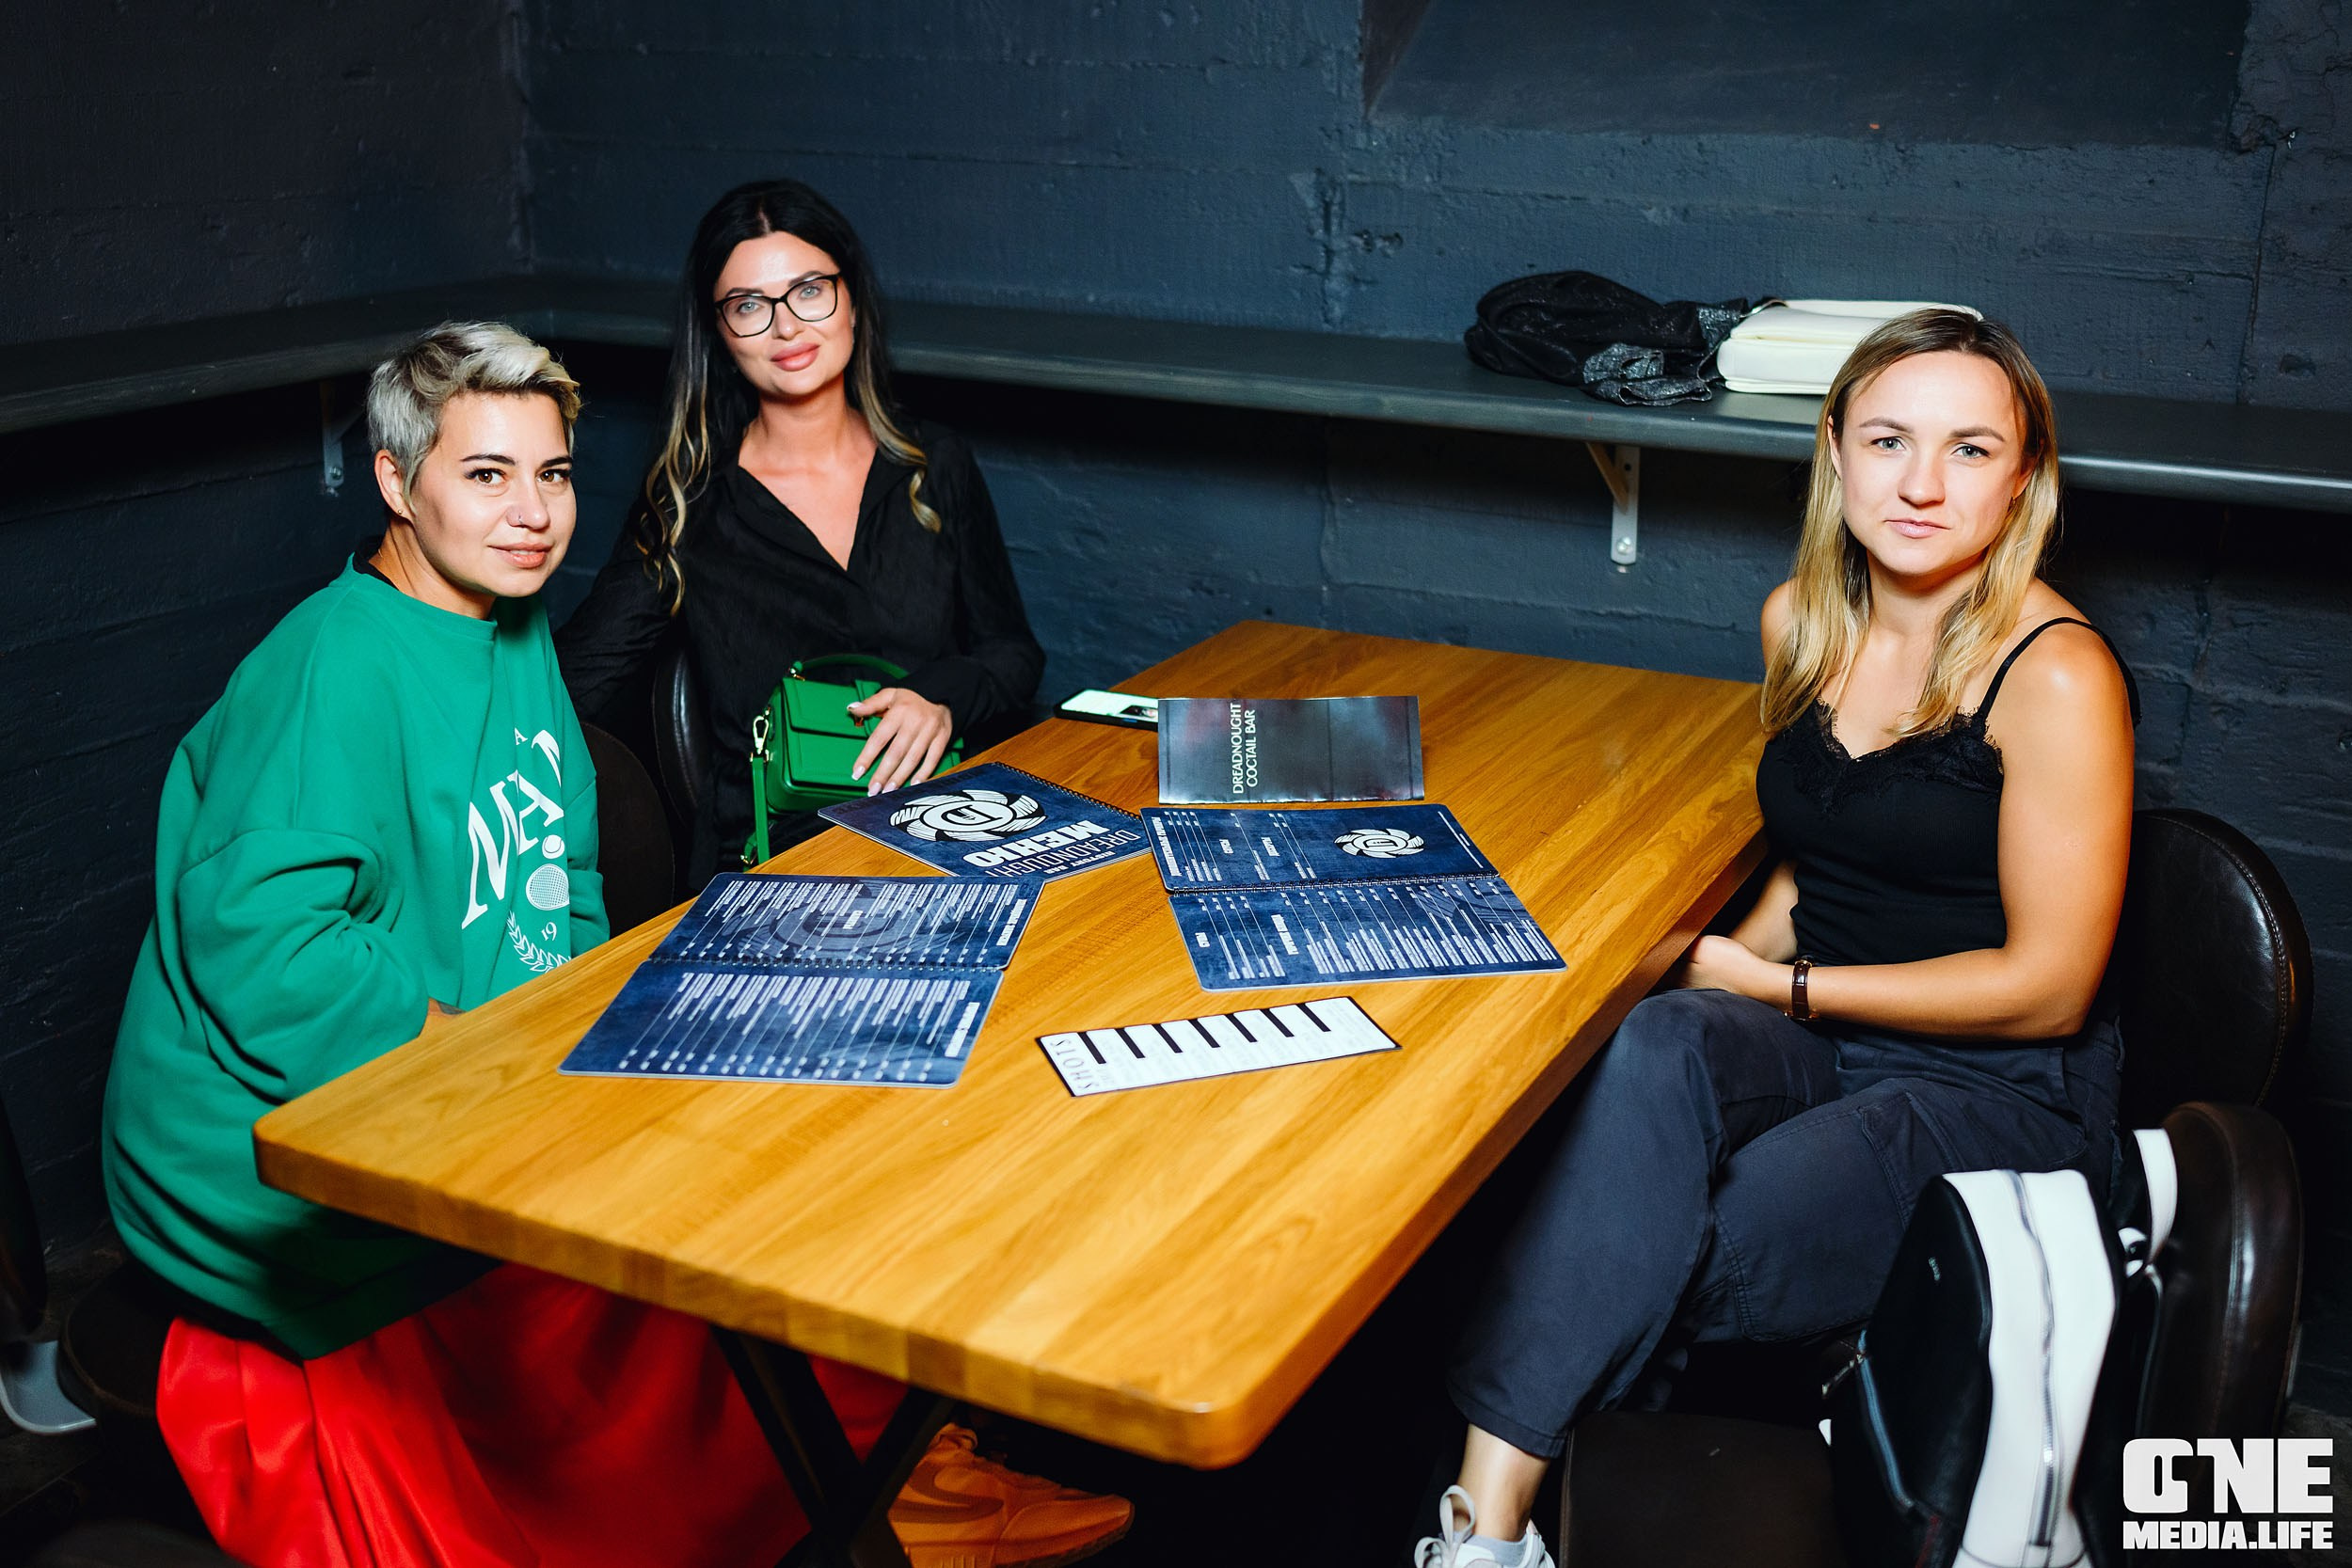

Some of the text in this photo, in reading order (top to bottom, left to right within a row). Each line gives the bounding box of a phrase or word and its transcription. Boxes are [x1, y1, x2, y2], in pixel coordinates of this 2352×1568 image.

[515, 727, 528, 746] A
[1231, 703, 1244, 794] DREADNOUGHT
[1245, 709, 1259, 788] COCTAIL BAR
[962, 820, 1111, 867] МЕНЮ
[540, 921, 558, 942] 19
